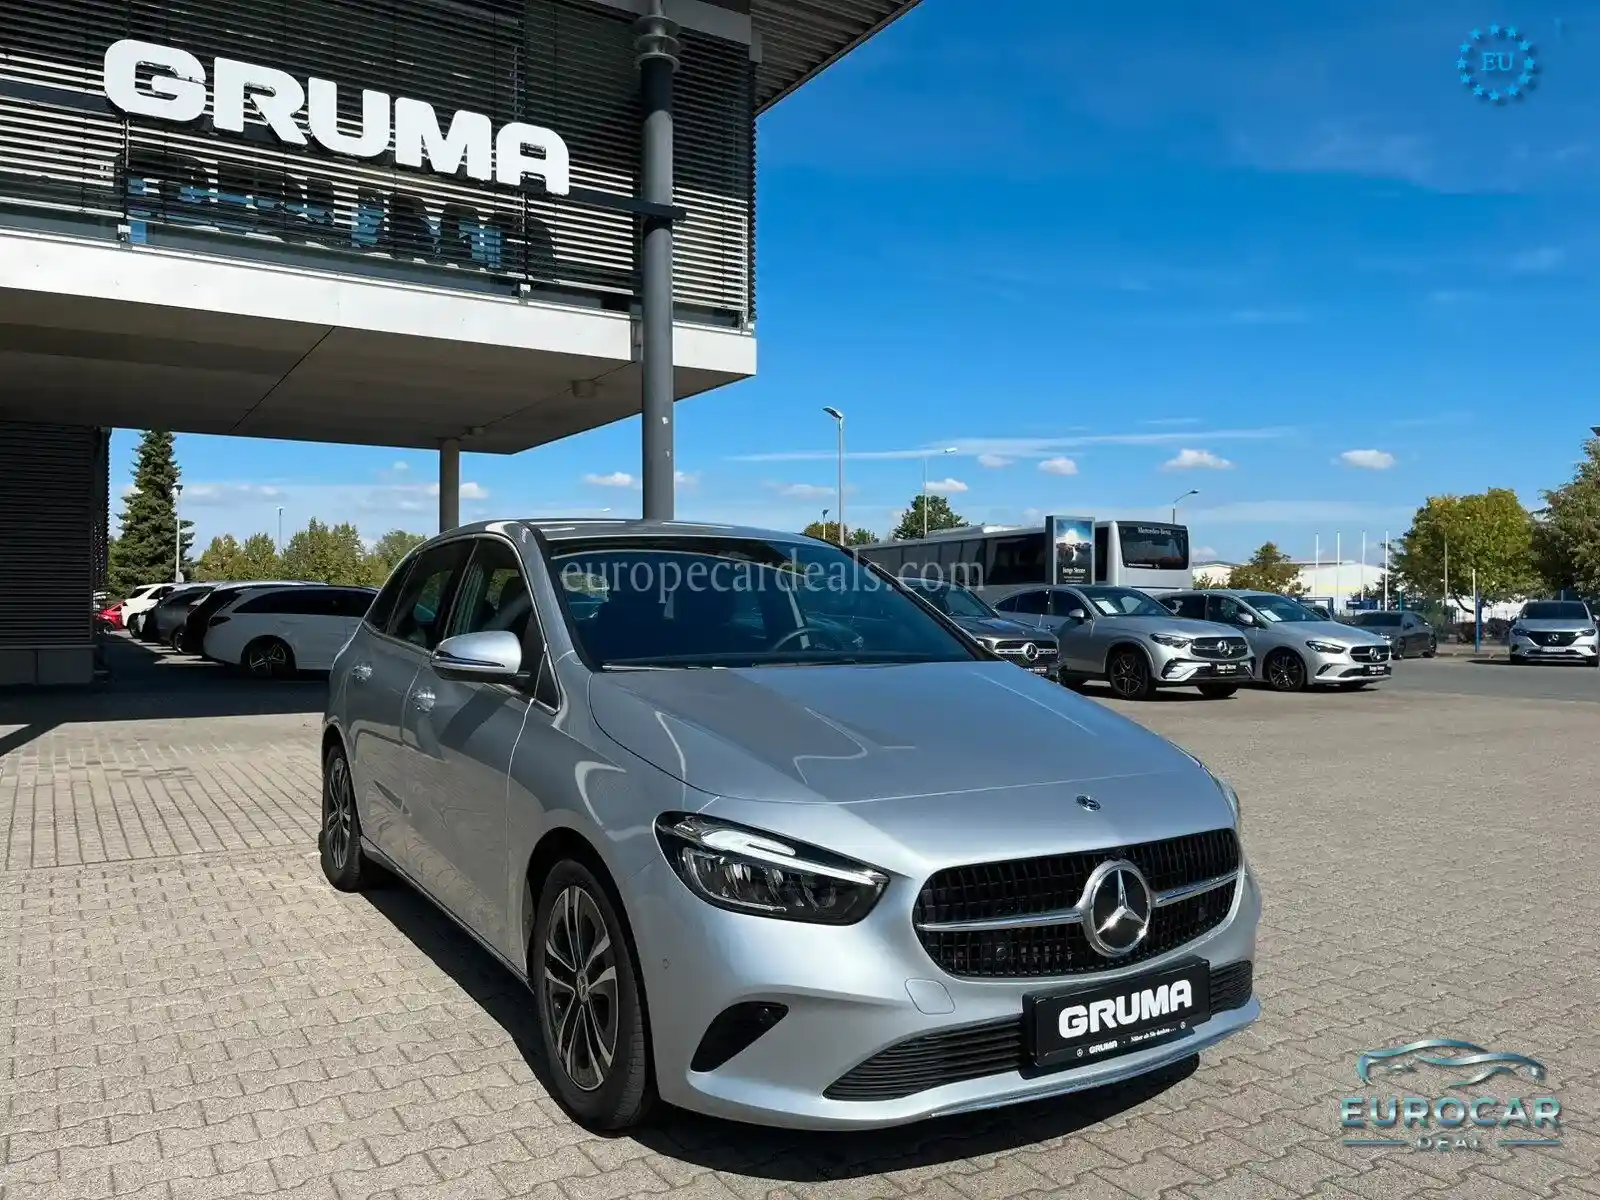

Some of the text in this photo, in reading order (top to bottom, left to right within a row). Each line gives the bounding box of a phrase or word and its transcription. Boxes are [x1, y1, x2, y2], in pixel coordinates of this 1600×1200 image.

[103, 38, 570, 196] GRUMA
[1058, 979, 1193, 1039] GRUMA
[1089, 1040, 1118, 1054] GRUMA
